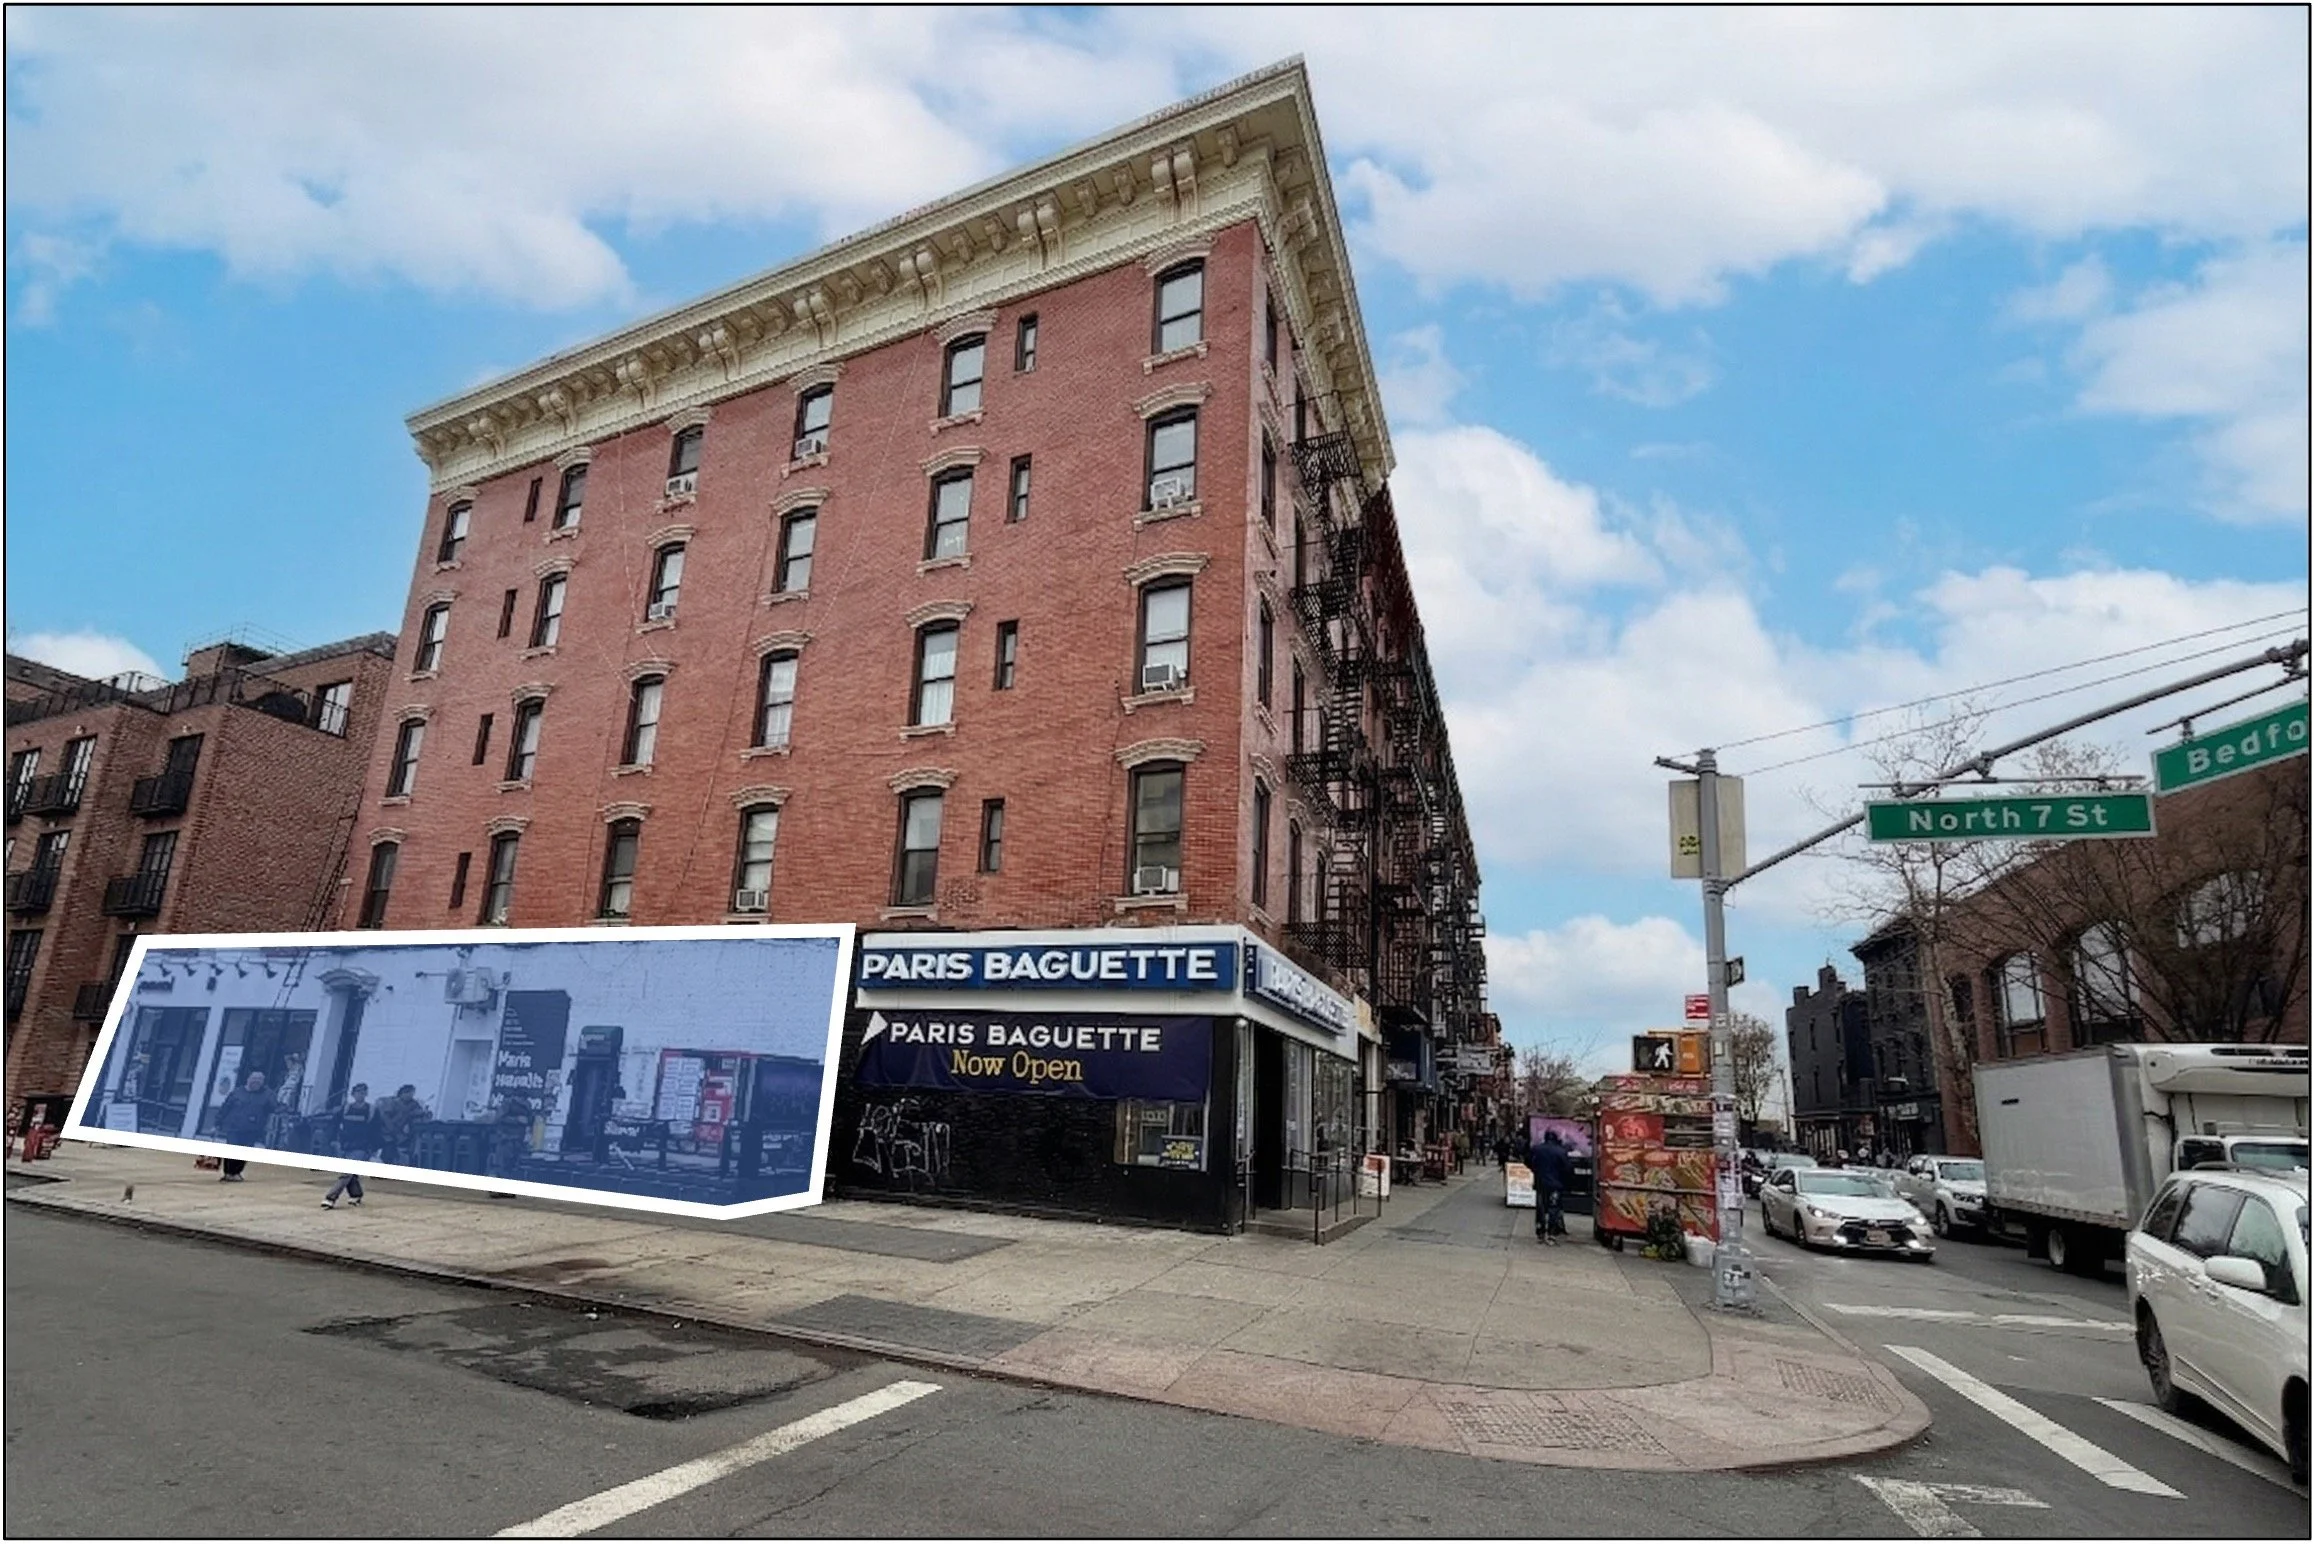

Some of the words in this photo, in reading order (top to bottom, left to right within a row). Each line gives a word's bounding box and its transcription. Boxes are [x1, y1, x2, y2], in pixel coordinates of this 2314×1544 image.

[2187, 718, 2307, 774] Bedfo
[1909, 807, 2021, 831] North
[2031, 805, 2052, 828] 7
[2066, 804, 2108, 826] St
[862, 953, 972, 979] PARIS
[984, 948, 1218, 979] BAGUETTE
[889, 1022, 975, 1045] PARIS
[986, 1024, 1161, 1051] BAGUETTE
[951, 1049, 1005, 1076] Now
[1012, 1051, 1083, 1084] Open
